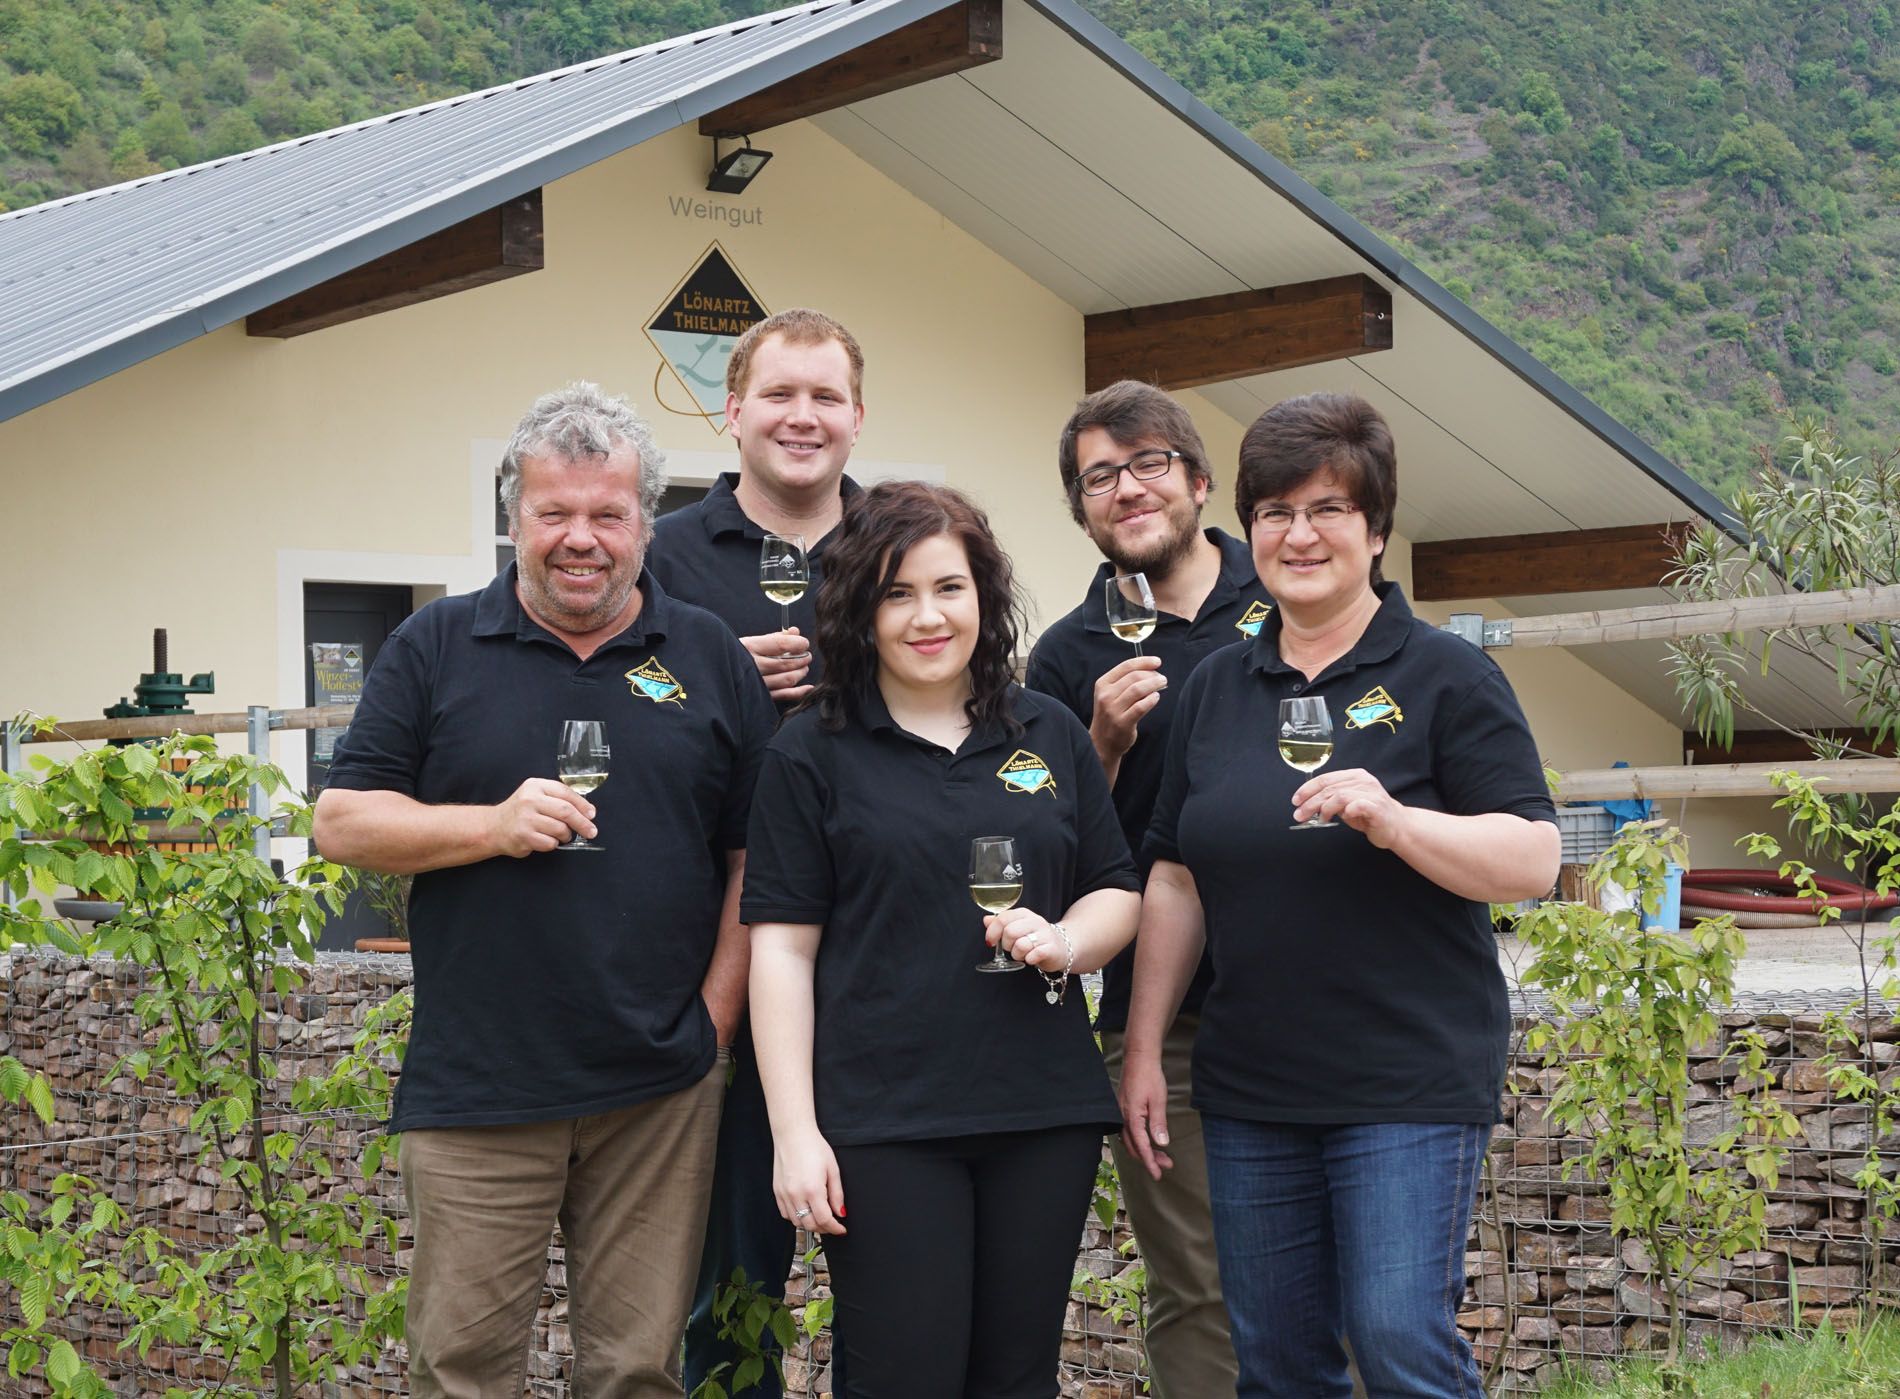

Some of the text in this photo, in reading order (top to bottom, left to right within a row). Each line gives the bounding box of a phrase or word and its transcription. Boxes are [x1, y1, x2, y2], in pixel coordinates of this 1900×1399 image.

[669, 195, 762, 228] Weingut
[683, 291, 750, 314] LÖNARTZ
[673, 311, 755, 334] THIELMAN
